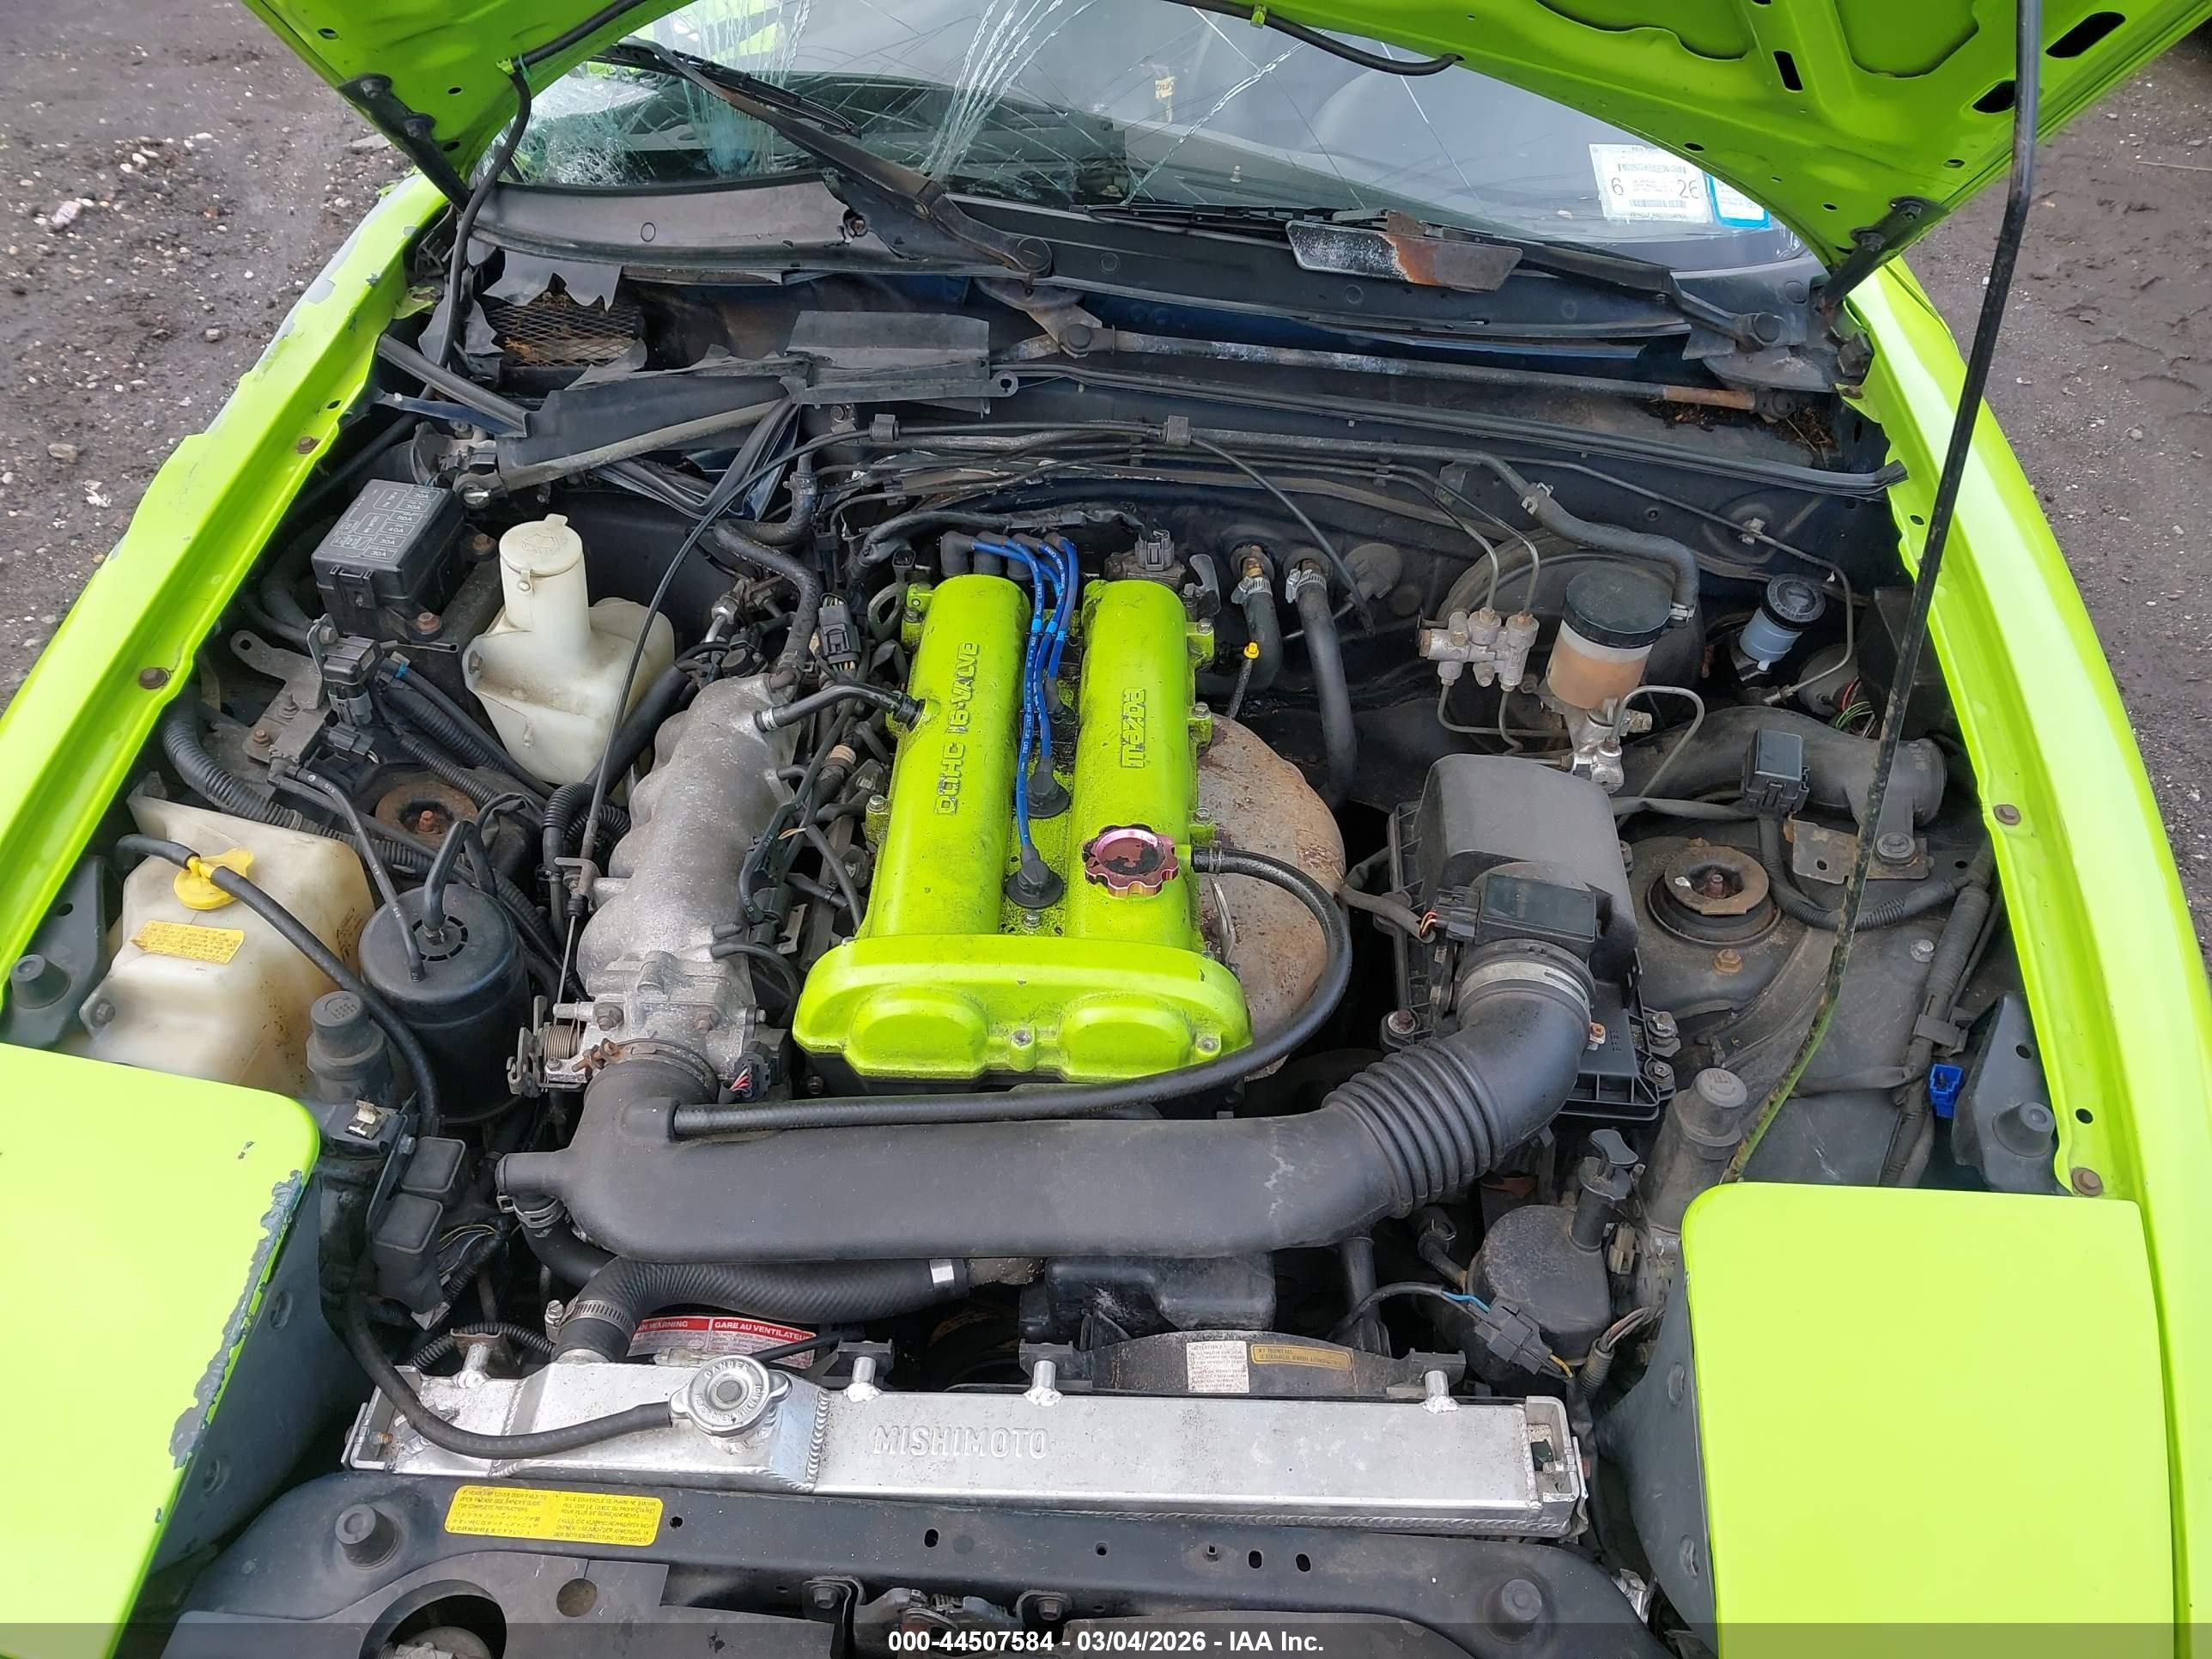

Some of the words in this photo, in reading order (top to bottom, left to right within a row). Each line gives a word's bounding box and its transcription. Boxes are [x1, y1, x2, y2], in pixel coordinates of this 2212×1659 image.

[1611, 177, 1624, 196] 6
[1120, 687, 1146, 769] mazda
[933, 741, 966, 816] DOHC
[649, 1320, 688, 1328] WARNING
[714, 1321, 738, 1329] GARE
[738, 1322, 752, 1331] AU
[873, 1425, 1050, 1459] MISHIMOTO
